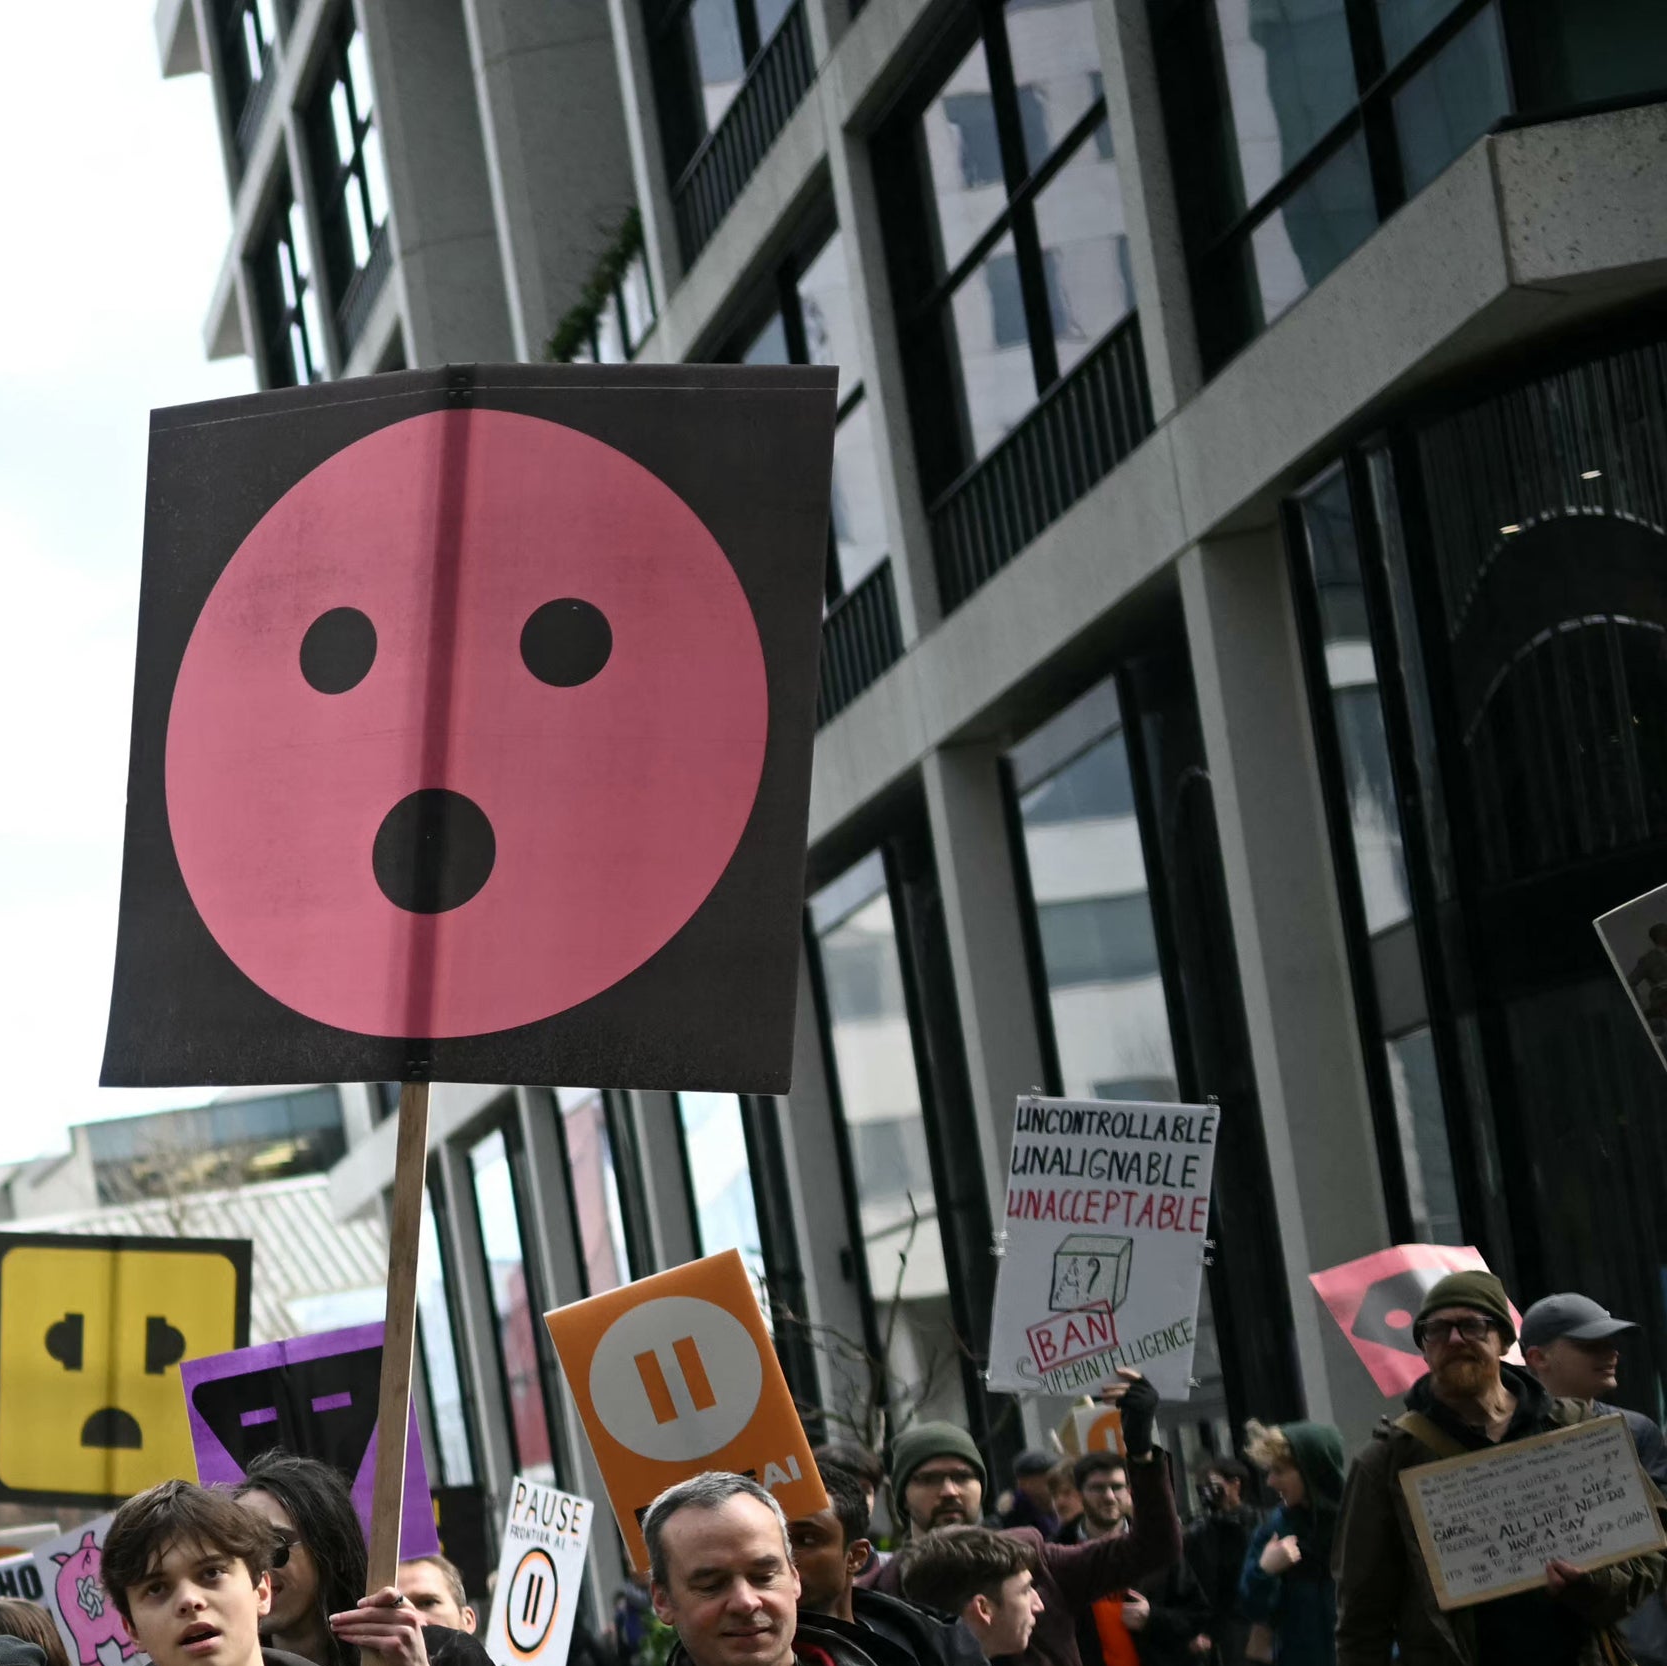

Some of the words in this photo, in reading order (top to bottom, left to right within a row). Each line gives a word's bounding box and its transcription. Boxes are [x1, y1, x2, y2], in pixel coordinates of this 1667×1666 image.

[1017, 1105, 1215, 1144] UNCONTROLLABLE
[1012, 1145, 1199, 1188] UNALIGNABLE
[1007, 1189, 1208, 1233] UNACCEPTABLE
[1017, 1318, 1194, 1395] SUPERINTELLIGENCE
[1035, 1313, 1109, 1363] BAN
[512, 1483, 584, 1536] PAUSE
[1496, 1519, 1528, 1539] ALL
[1532, 1506, 1569, 1527] LIFE
[1574, 1487, 1627, 1512] NEEDS
[1507, 1532, 1540, 1551] HAVE
[1542, 1527, 1555, 1540] A
[1558, 1517, 1587, 1534] SAY
